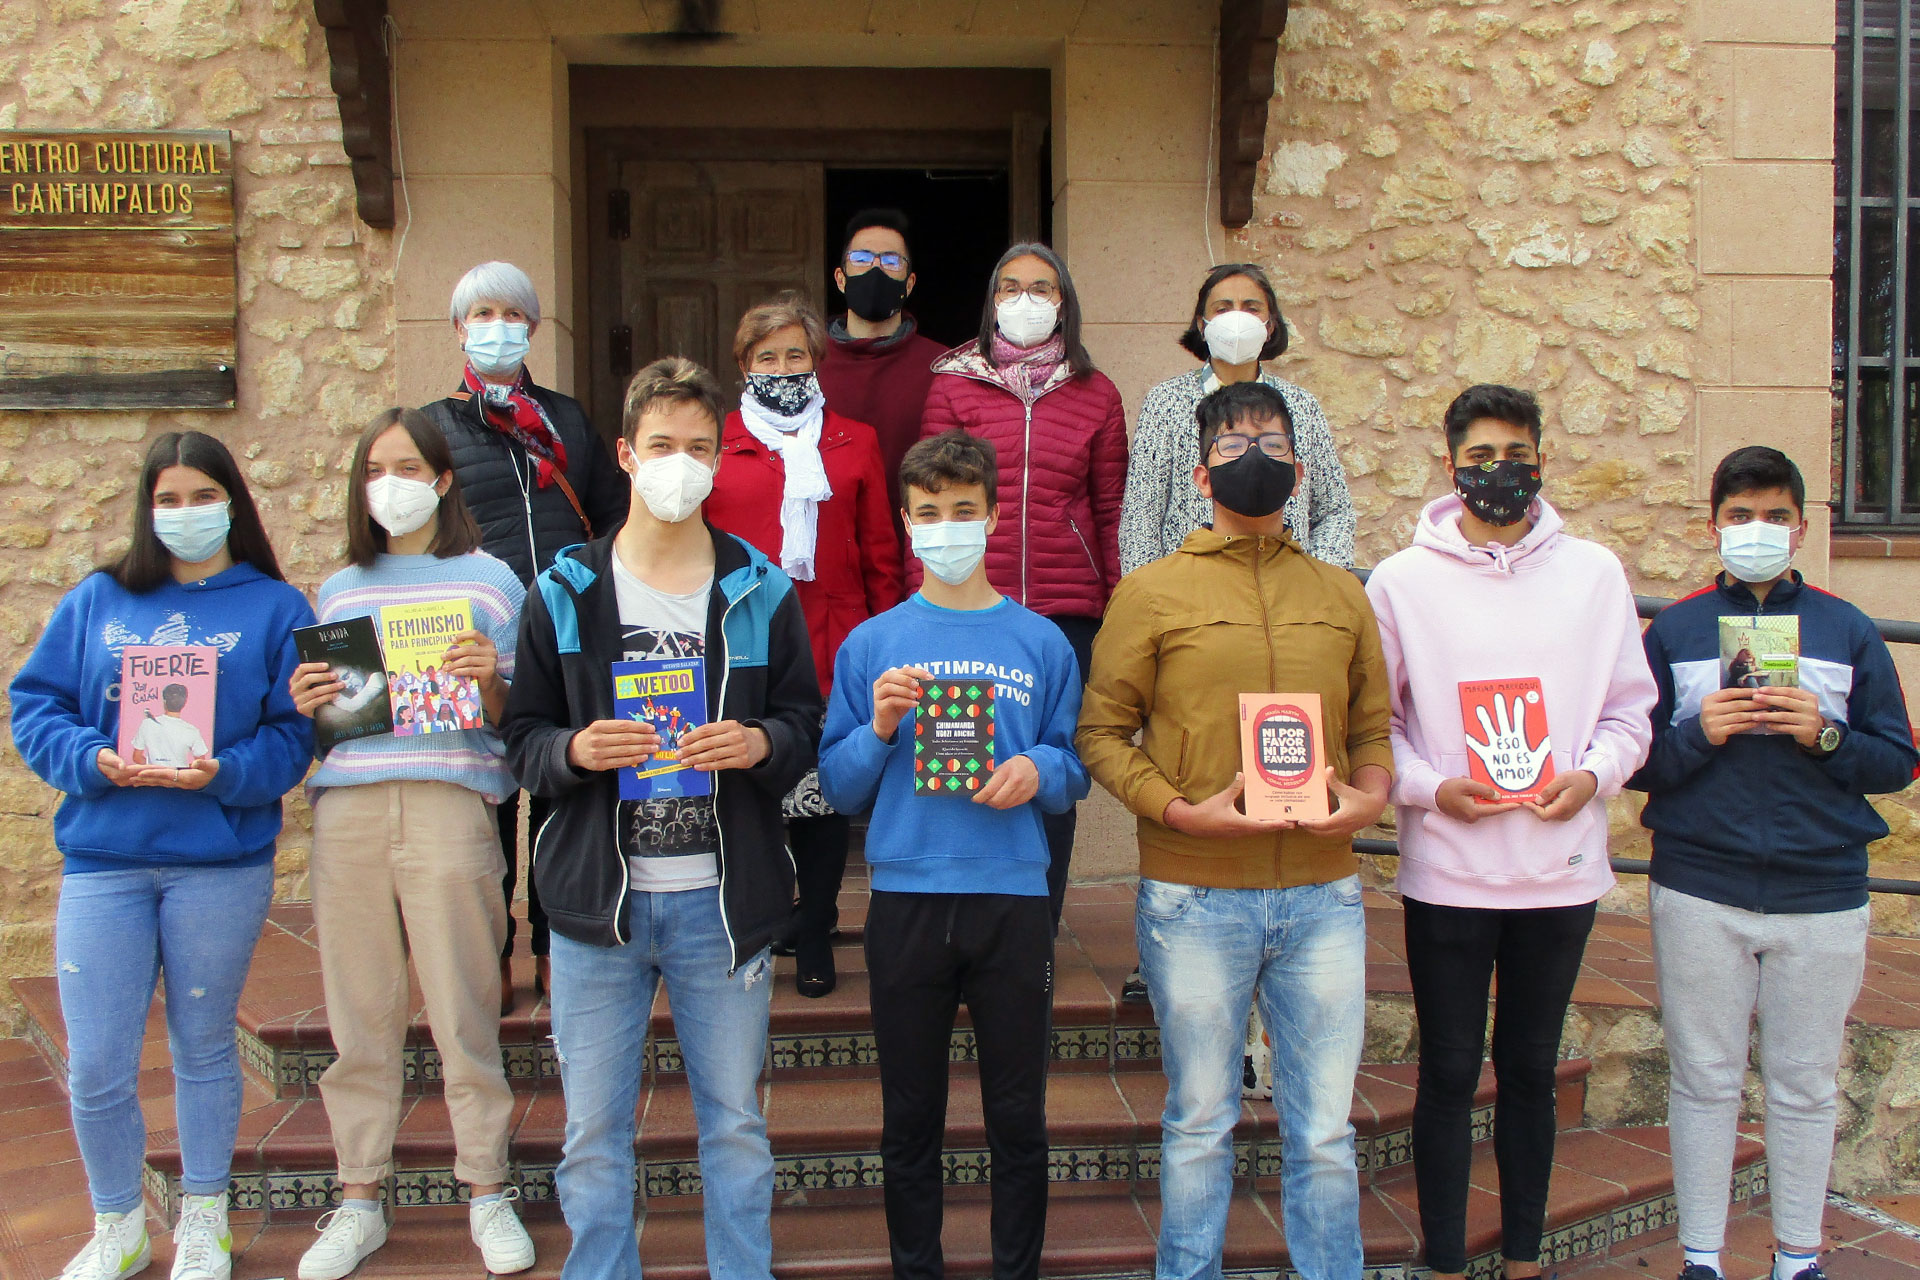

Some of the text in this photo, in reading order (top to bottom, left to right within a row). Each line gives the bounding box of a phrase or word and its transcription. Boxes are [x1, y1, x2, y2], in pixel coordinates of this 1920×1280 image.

[95, 142, 221, 174] CULTURAL
[12, 182, 194, 214] CANTIMPALOS
[388, 613, 465, 639] FEMINISMO
[390, 639, 409, 650] PARA
[129, 653, 210, 677] FUERTE
[888, 661, 1034, 688] NTIMPALOS
[132, 682, 147, 692] ROY
[617, 672, 692, 697] #WETOO
[132, 687, 158, 705] GALÁN
[1262, 728, 1305, 738] NI POR
[1263, 737, 1304, 747] FAVOR
[1496, 737, 1520, 749] ESO
[1263, 747, 1306, 756] NI POR
[1264, 756, 1307, 764] FAVORA
[1493, 753, 1530, 765] NO ES
[1496, 767, 1534, 781] AMOR
